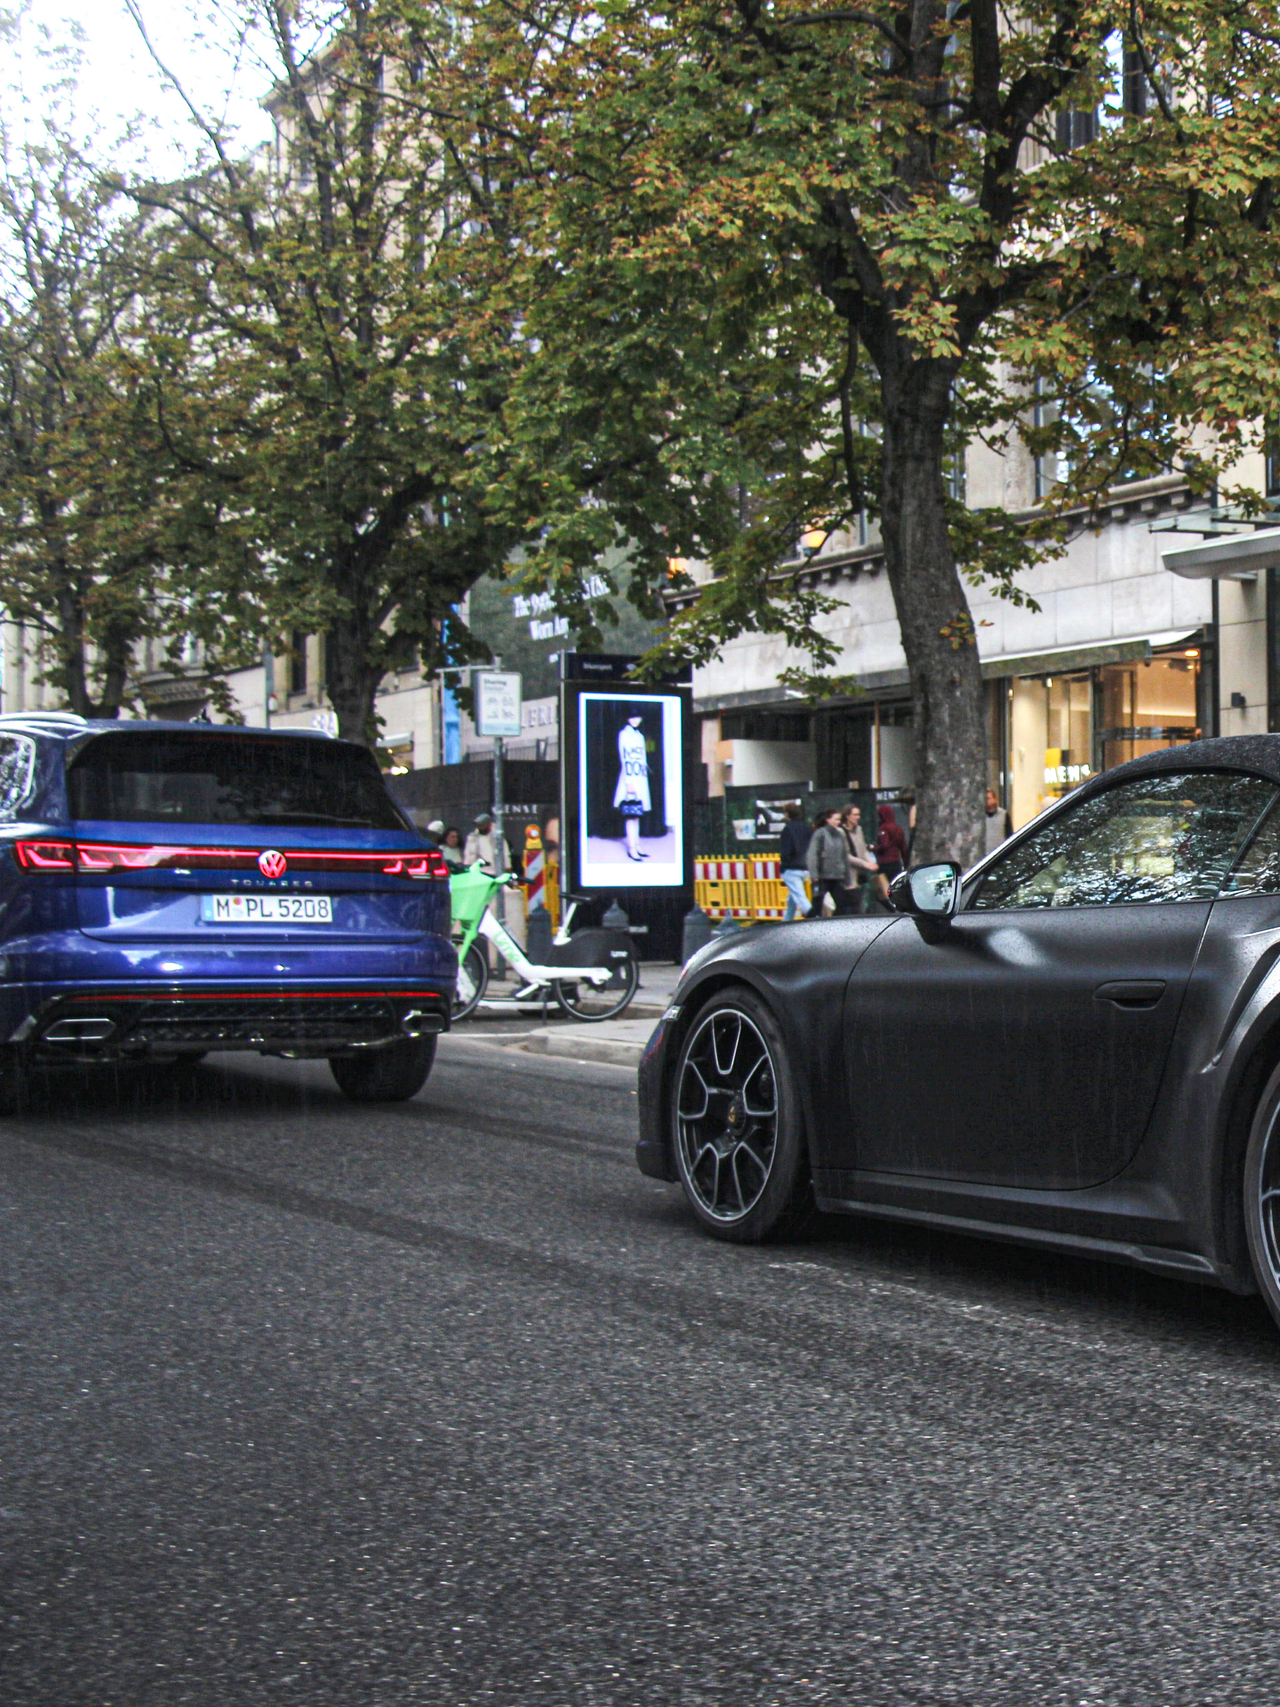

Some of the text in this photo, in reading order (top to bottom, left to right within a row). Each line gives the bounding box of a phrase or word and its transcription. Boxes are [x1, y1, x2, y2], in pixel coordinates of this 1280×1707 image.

[216, 898, 329, 918] M PL 5208
